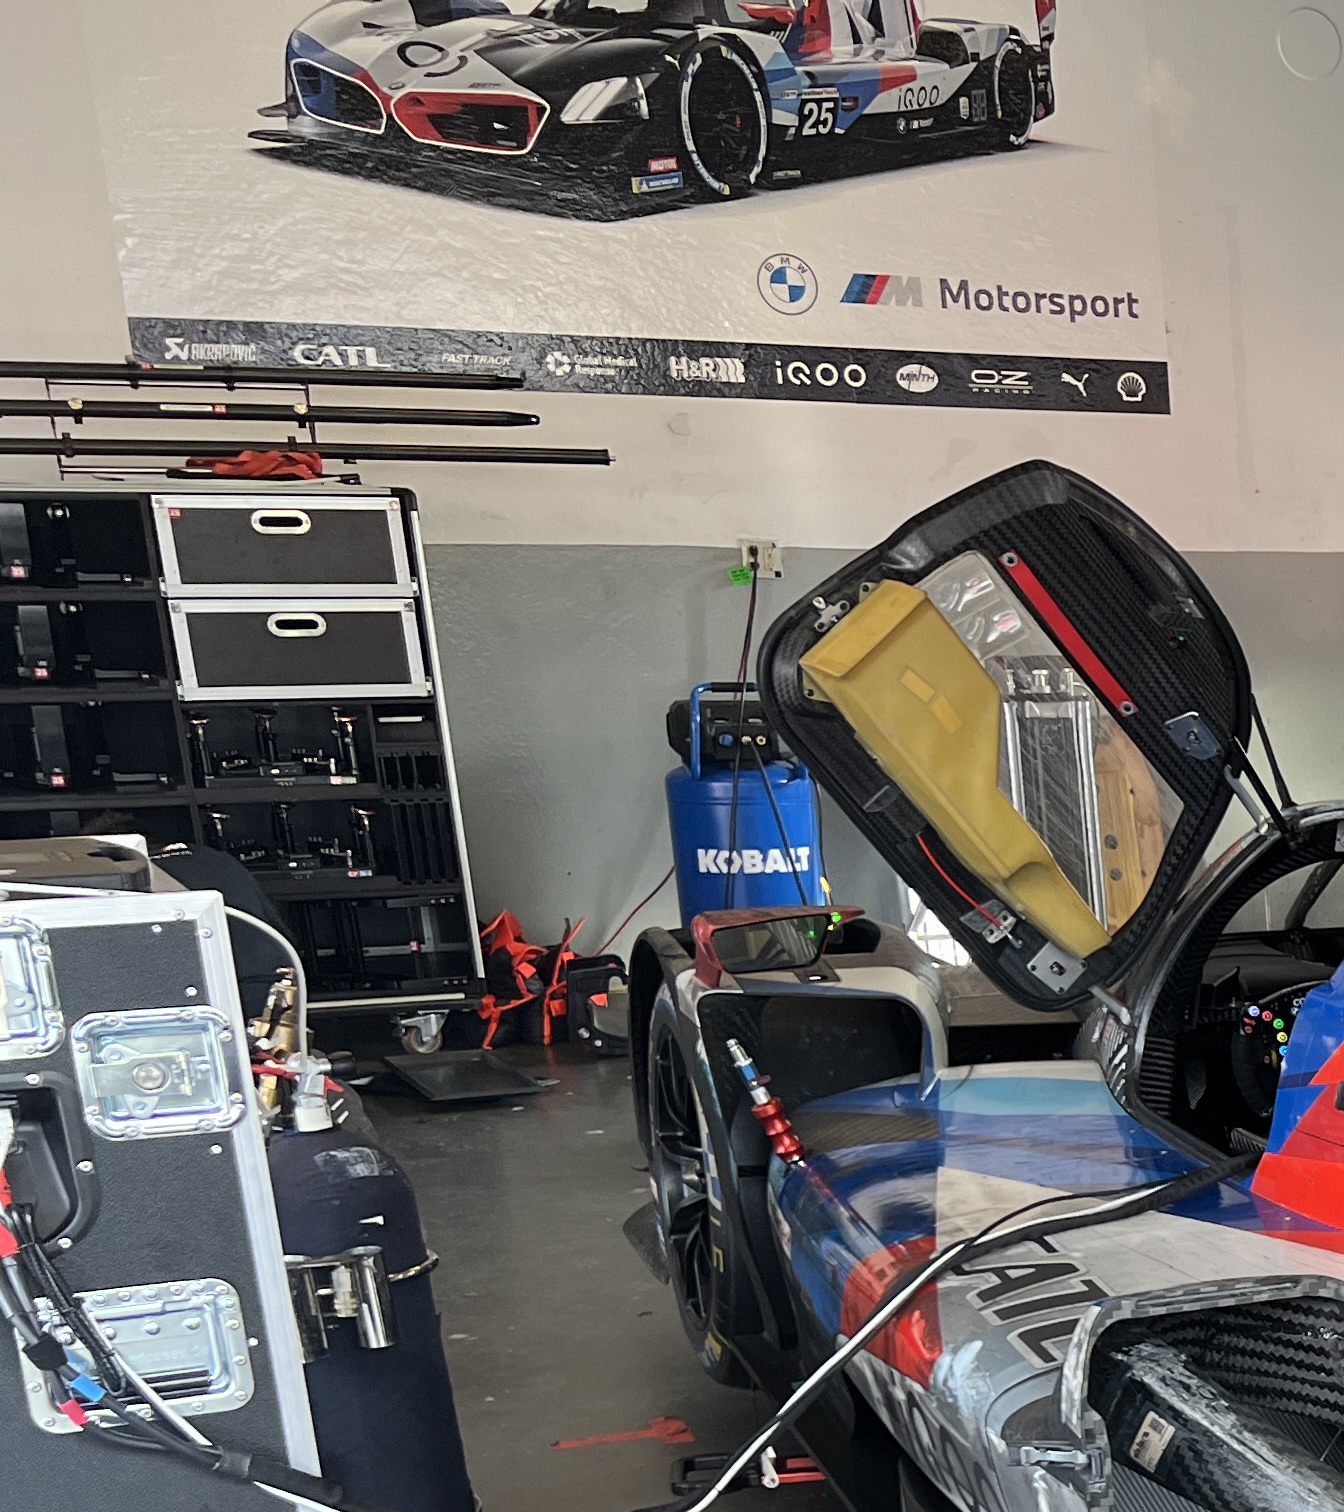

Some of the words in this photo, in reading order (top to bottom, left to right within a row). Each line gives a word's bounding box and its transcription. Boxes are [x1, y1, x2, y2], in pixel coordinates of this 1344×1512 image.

[897, 85, 940, 111] iQOO
[801, 101, 835, 136] 25
[938, 277, 1140, 323] Motorsport
[293, 341, 392, 368] CATL
[774, 360, 867, 388] iQOO
[697, 846, 811, 876] KOBALT
